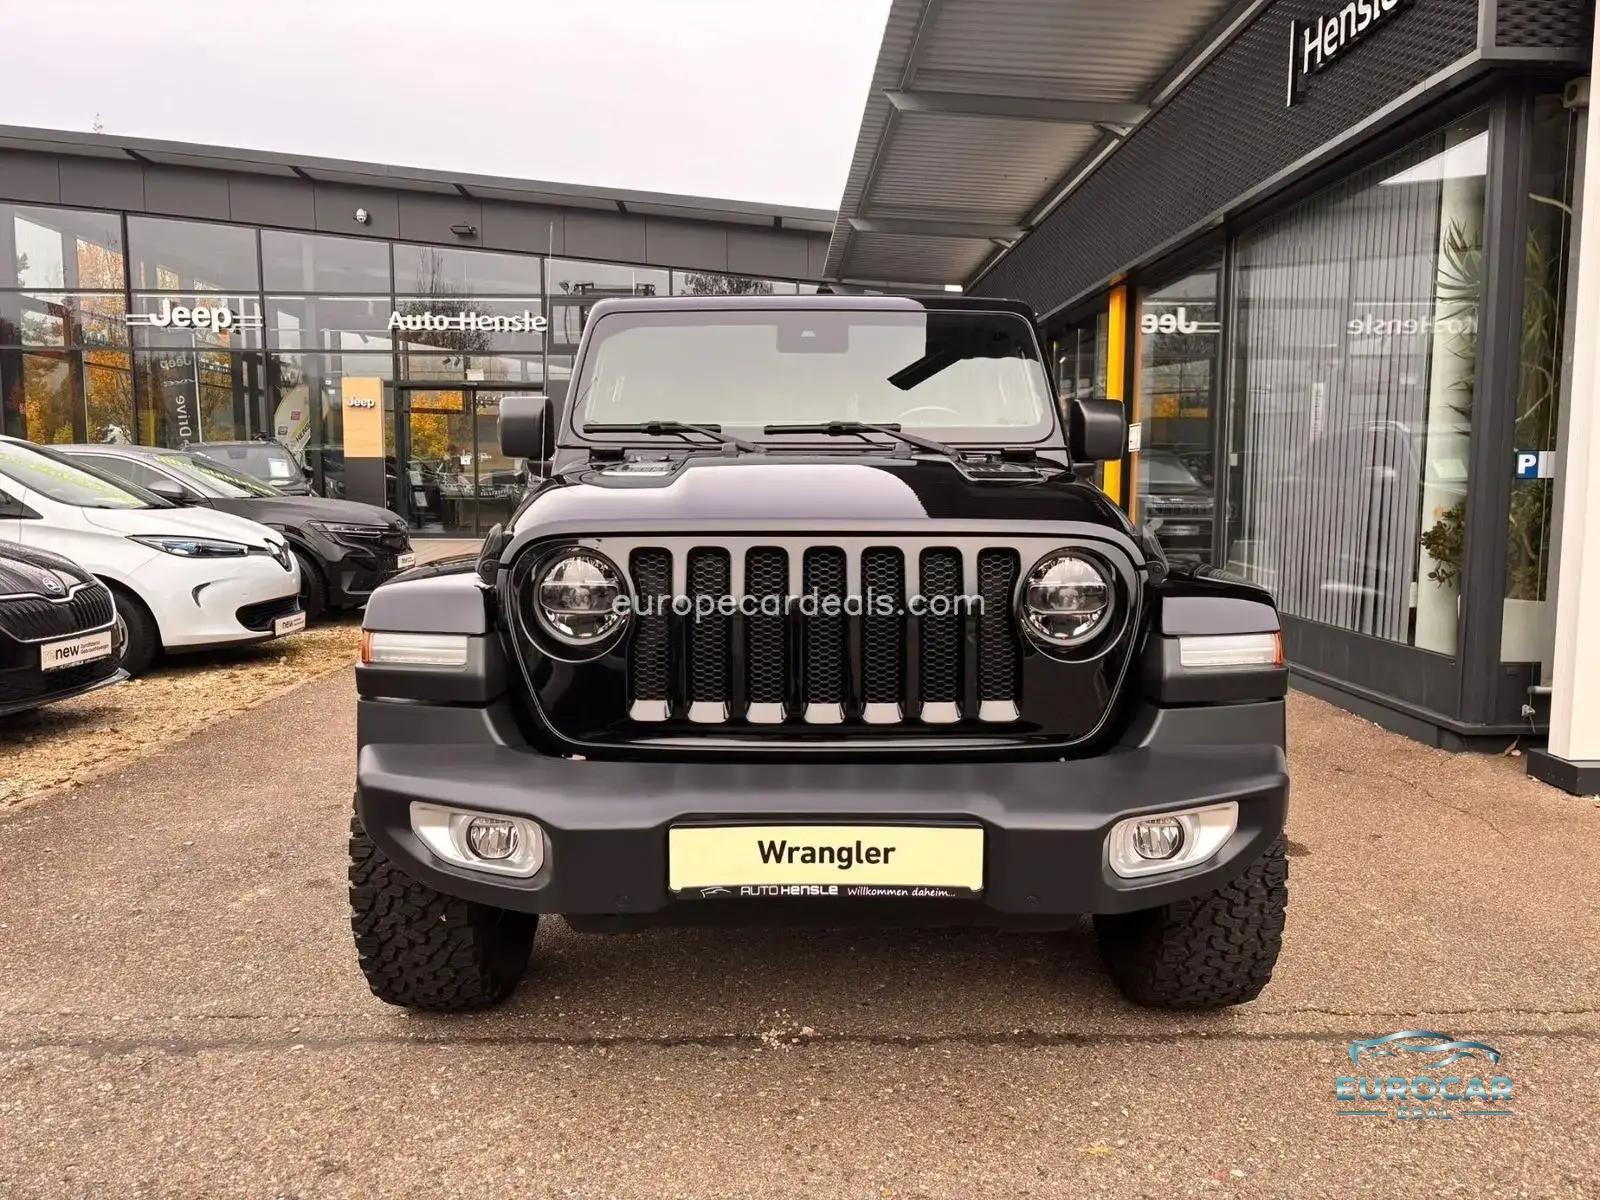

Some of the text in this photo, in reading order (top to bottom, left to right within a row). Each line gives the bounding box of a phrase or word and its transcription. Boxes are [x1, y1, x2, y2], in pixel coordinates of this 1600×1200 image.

[1304, 0, 1398, 74] Hens
[150, 298, 232, 332] Jeep
[388, 310, 547, 332] Auto Hensle
[347, 396, 376, 409] Jeep
[1517, 454, 1537, 474] P
[757, 840, 896, 870] Wrangler
[740, 885, 779, 896] AUTO
[847, 887, 909, 897] Willkommen
